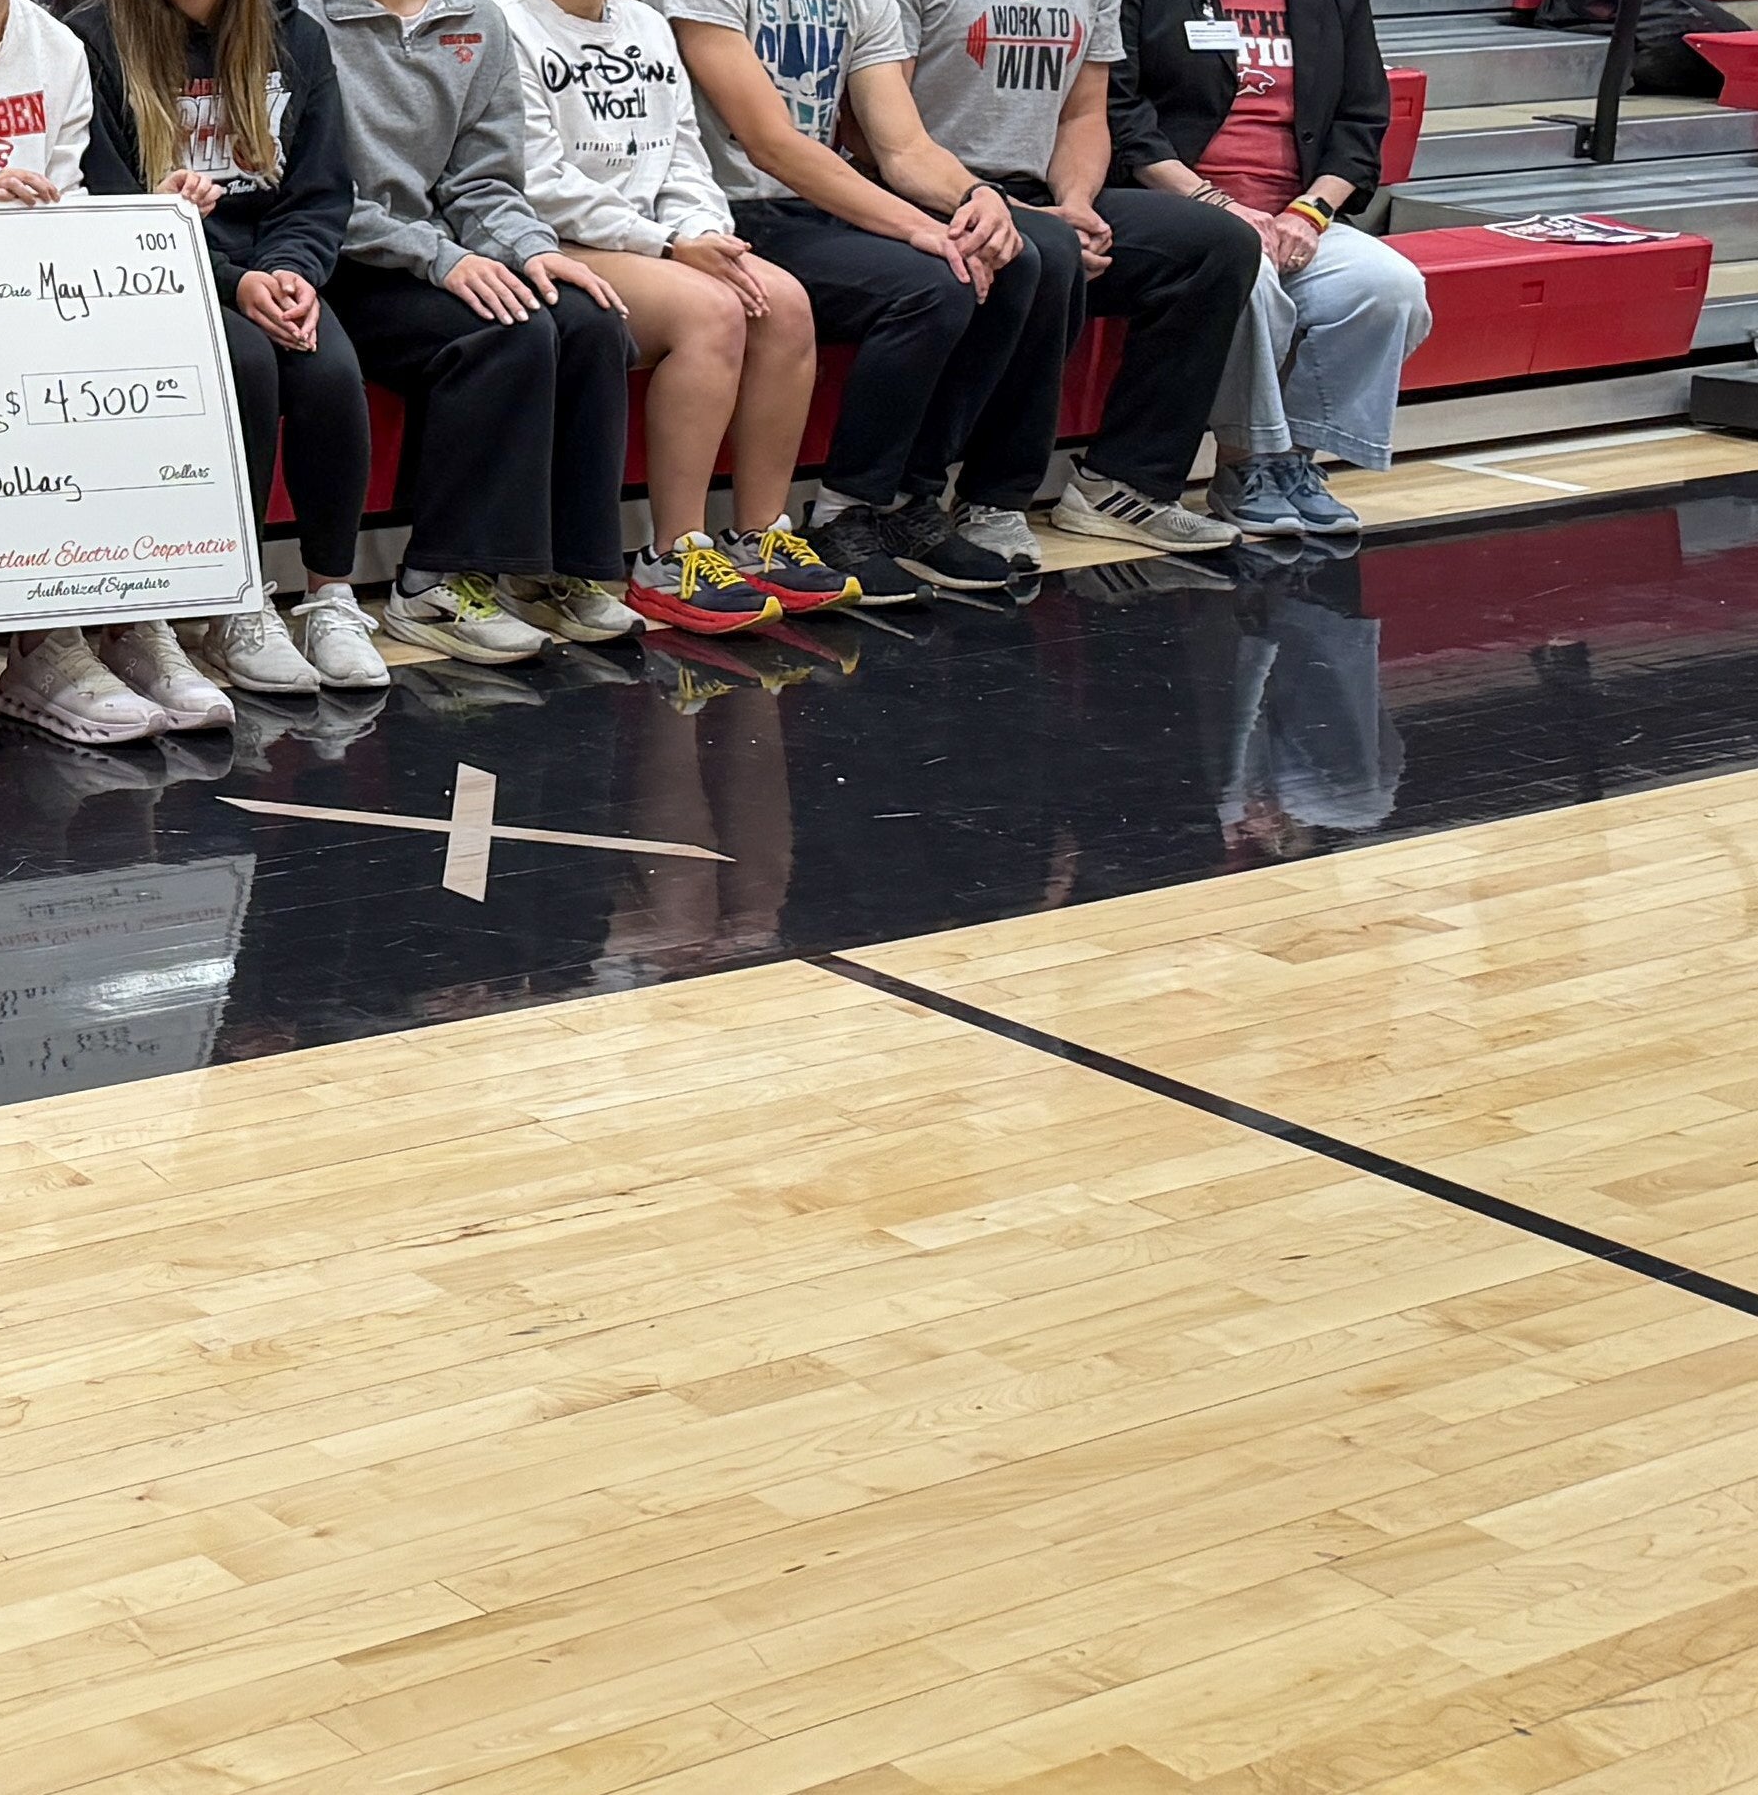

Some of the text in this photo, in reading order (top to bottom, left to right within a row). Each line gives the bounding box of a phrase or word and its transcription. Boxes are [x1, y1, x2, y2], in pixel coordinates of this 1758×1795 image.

[992, 5, 1069, 38] WORK TO
[996, 44, 1063, 91] WIN
[135, 232, 177, 251] 1001
[39, 261, 90, 321] May
[5, 390, 22, 417] $
[159, 464, 210, 481] Dollars
[54, 540, 129, 567] Electric
[134, 535, 238, 562] Cooperative
[27, 576, 170, 600] Authorized Signature
